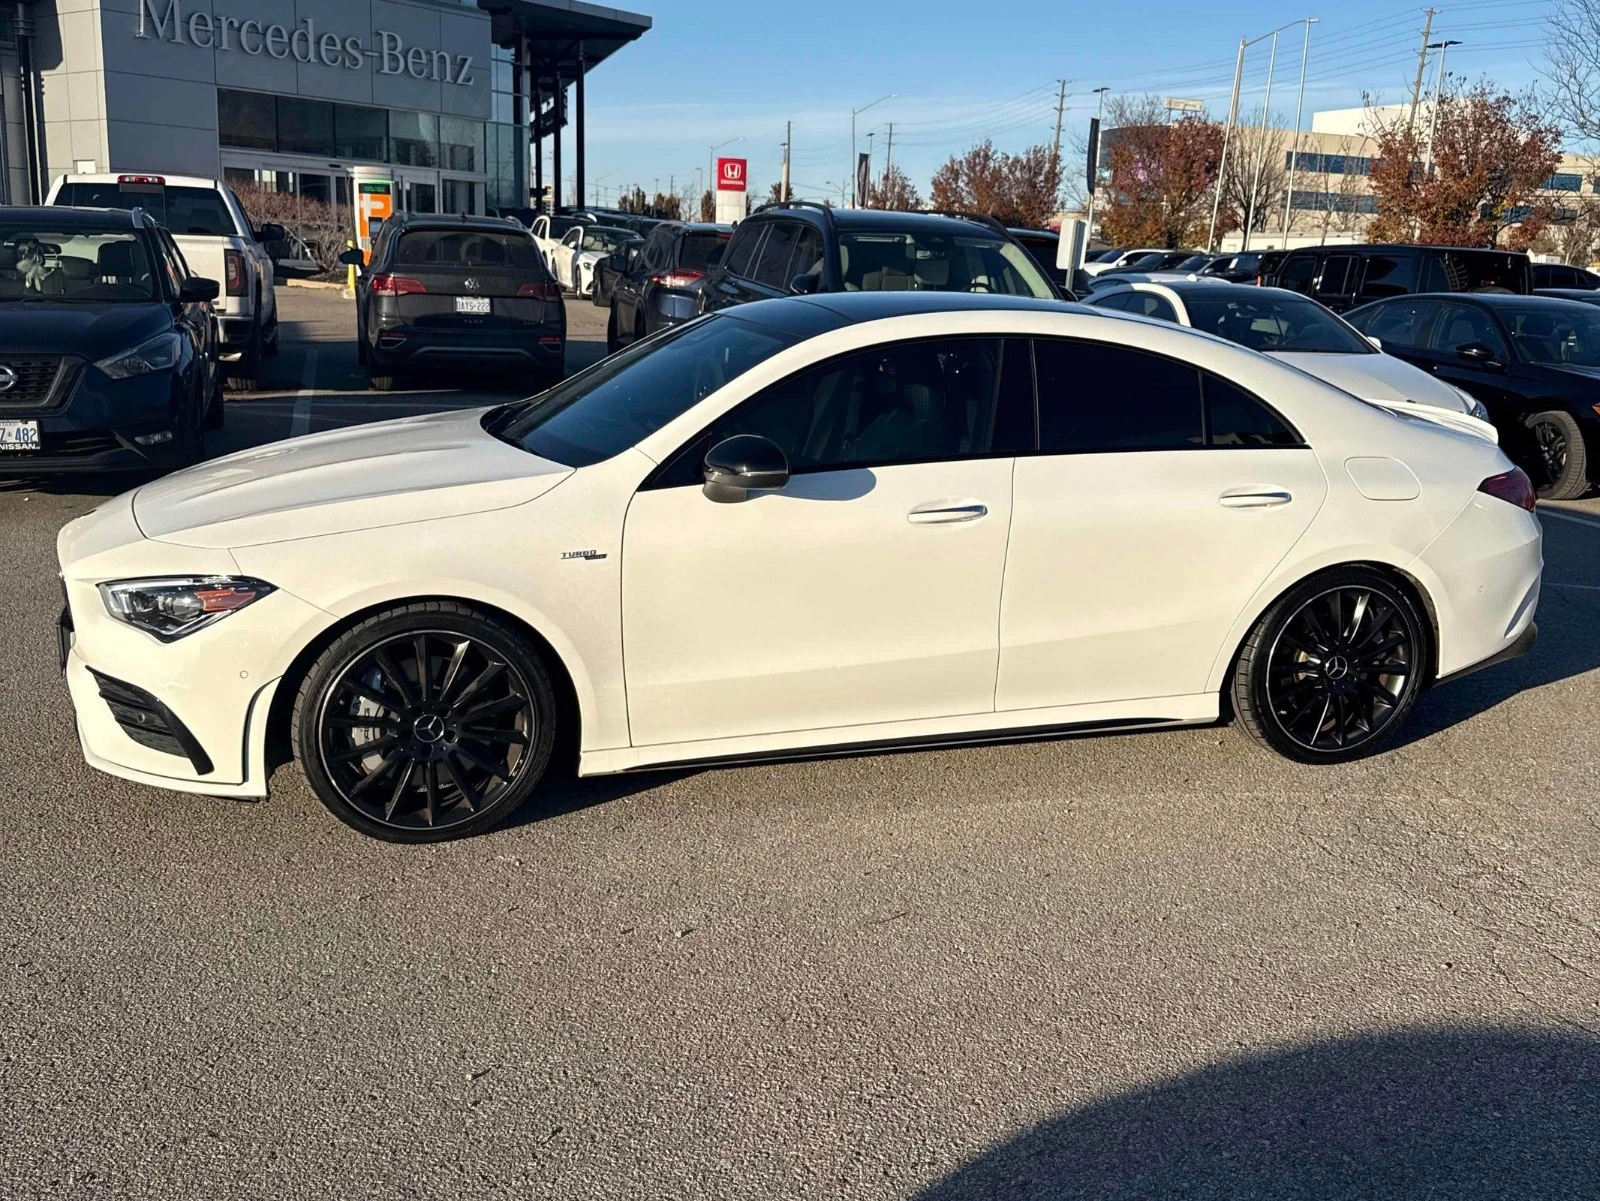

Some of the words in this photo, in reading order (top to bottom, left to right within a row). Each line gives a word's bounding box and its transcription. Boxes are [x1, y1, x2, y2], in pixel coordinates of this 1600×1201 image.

[135, 0, 474, 86] Mercedes-Benz
[15, 427, 37, 442] 482
[560, 550, 597, 558] TURBO
